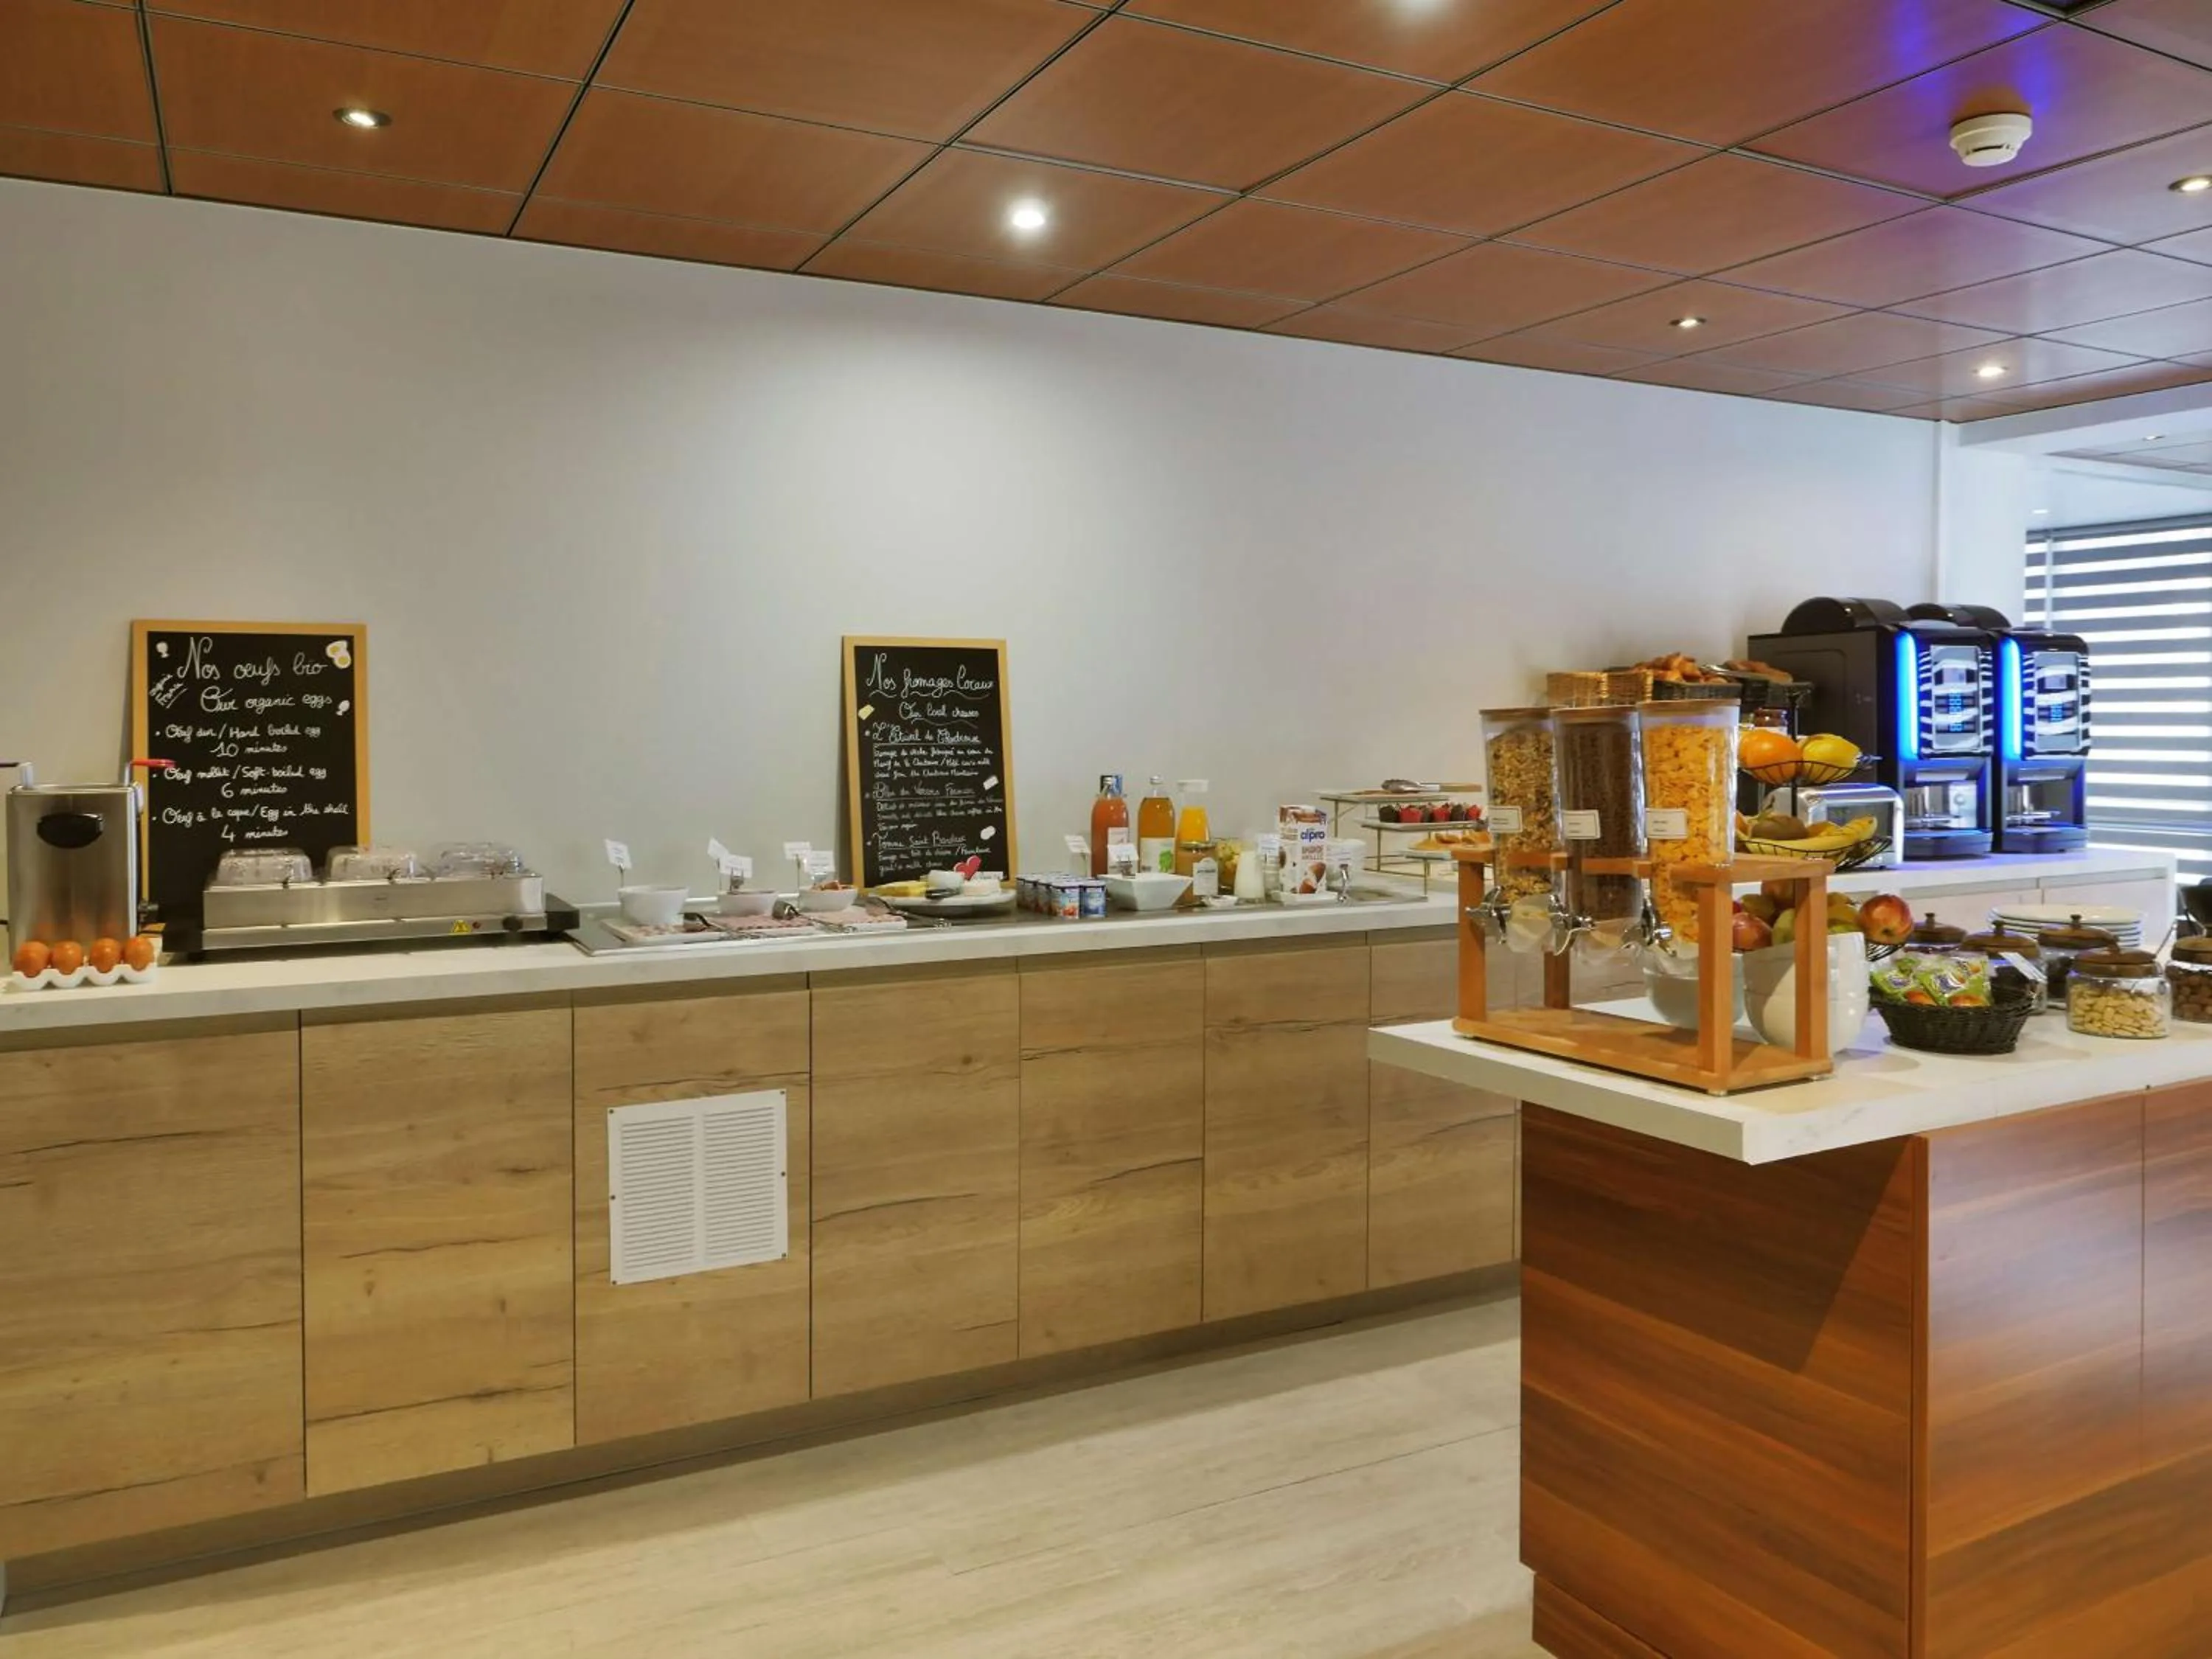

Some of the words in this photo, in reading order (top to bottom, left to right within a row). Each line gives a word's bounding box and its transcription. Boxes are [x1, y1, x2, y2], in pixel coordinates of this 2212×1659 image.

[177, 636, 220, 680] Nos
[293, 652, 327, 676] bio
[866, 653, 897, 690] Nos
[900, 668, 954, 699] fromages
[245, 695, 296, 714] organic
[302, 693, 333, 709] eggs
[209, 742, 240, 758] 10
[244, 740, 288, 754] minutes
[221, 782, 234, 799] 6
[240, 782, 288, 796] minutes
[221, 824, 236, 843] 4
[244, 826, 288, 839] minutes
[1300, 830, 1325, 842] alpro
